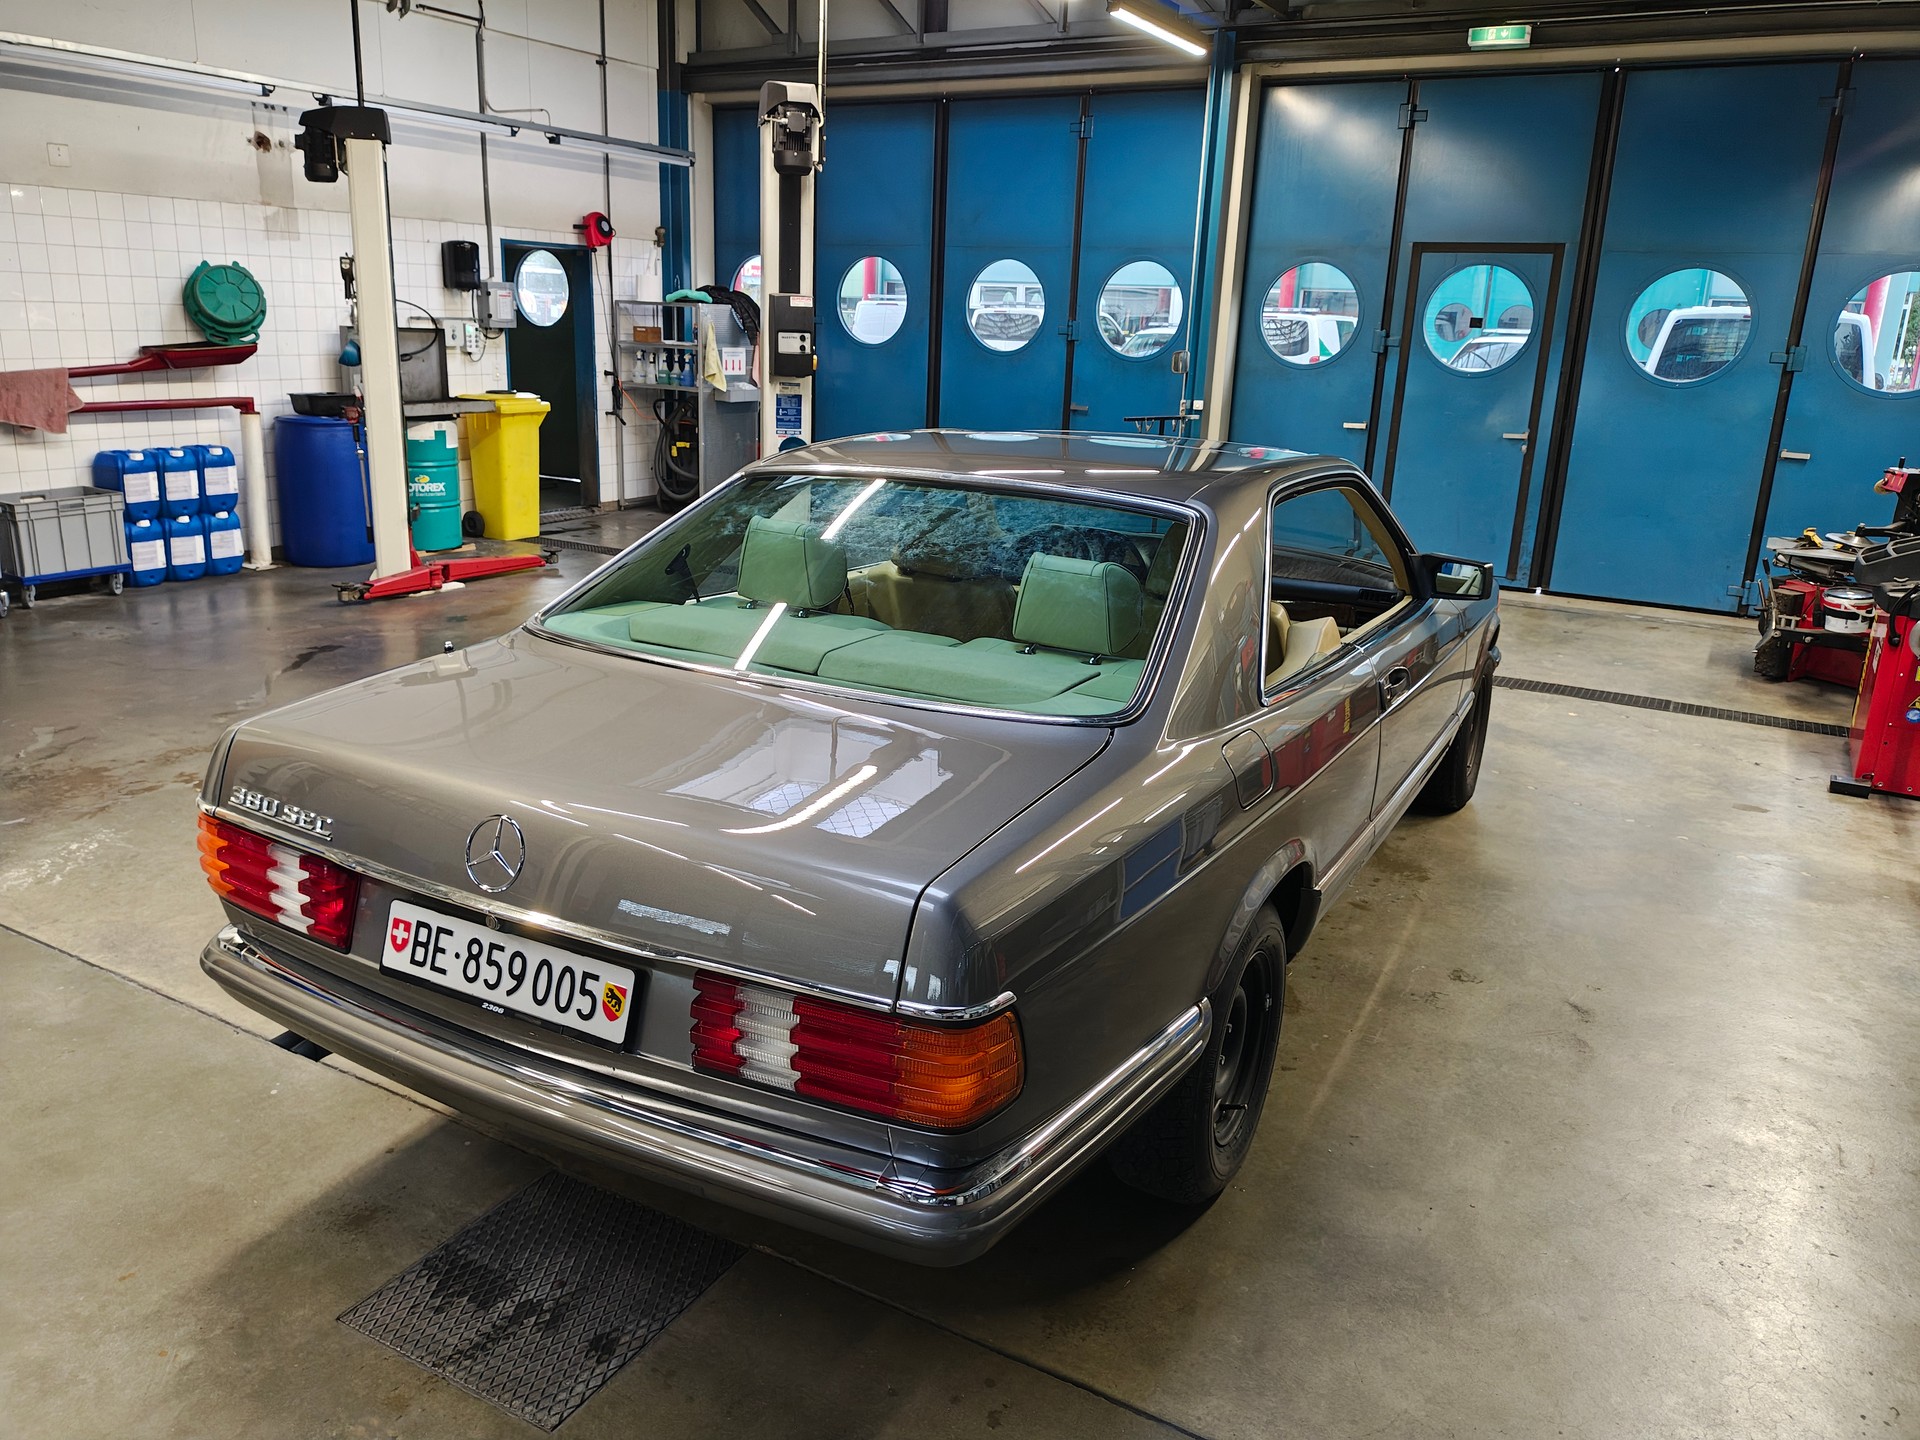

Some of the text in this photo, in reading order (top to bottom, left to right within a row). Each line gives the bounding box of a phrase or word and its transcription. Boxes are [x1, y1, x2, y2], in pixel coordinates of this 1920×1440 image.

[408, 482, 446, 492] OTOREX
[230, 785, 334, 837] 380 SEC
[481, 1002, 505, 1014] 2306
